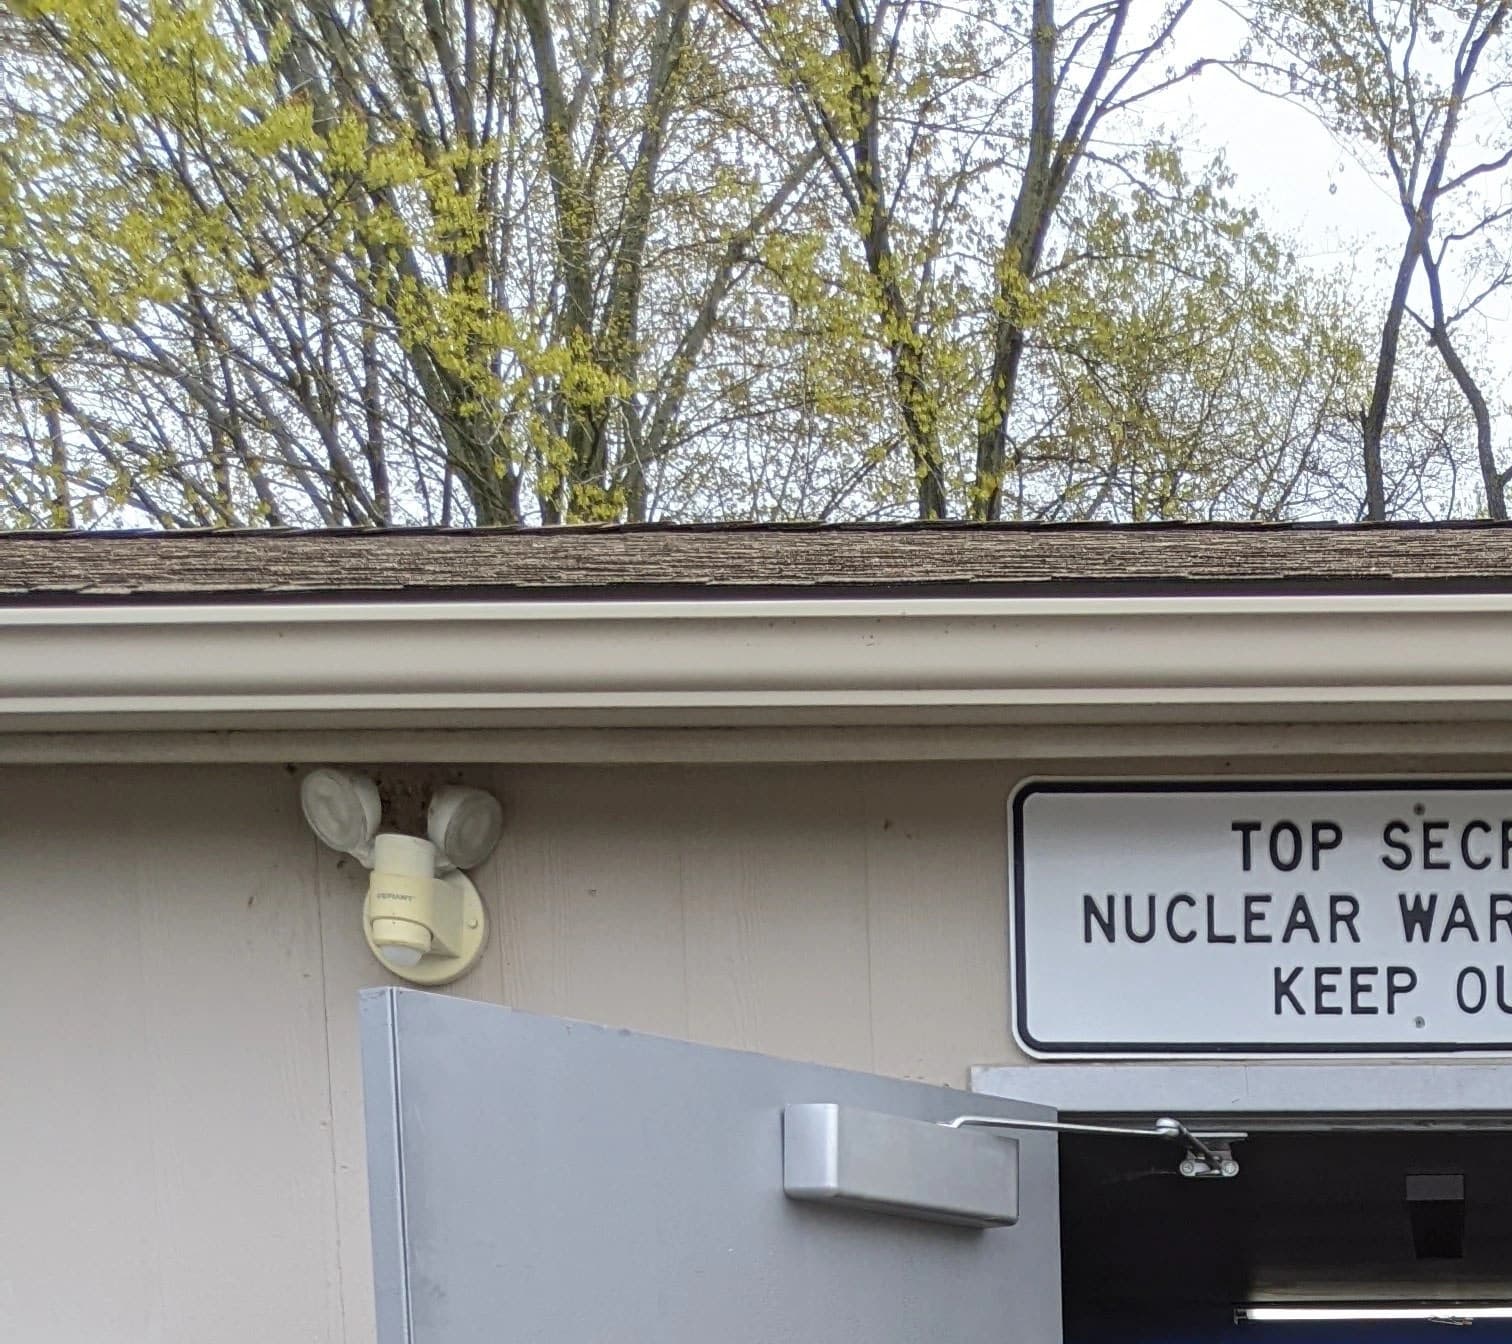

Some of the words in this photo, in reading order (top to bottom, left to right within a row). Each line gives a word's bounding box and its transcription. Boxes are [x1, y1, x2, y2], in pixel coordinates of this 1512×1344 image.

[1231, 816, 1343, 873] TOP
[1083, 893, 1361, 945] NUCLEAR
[1274, 966, 1418, 1016] KEEP
